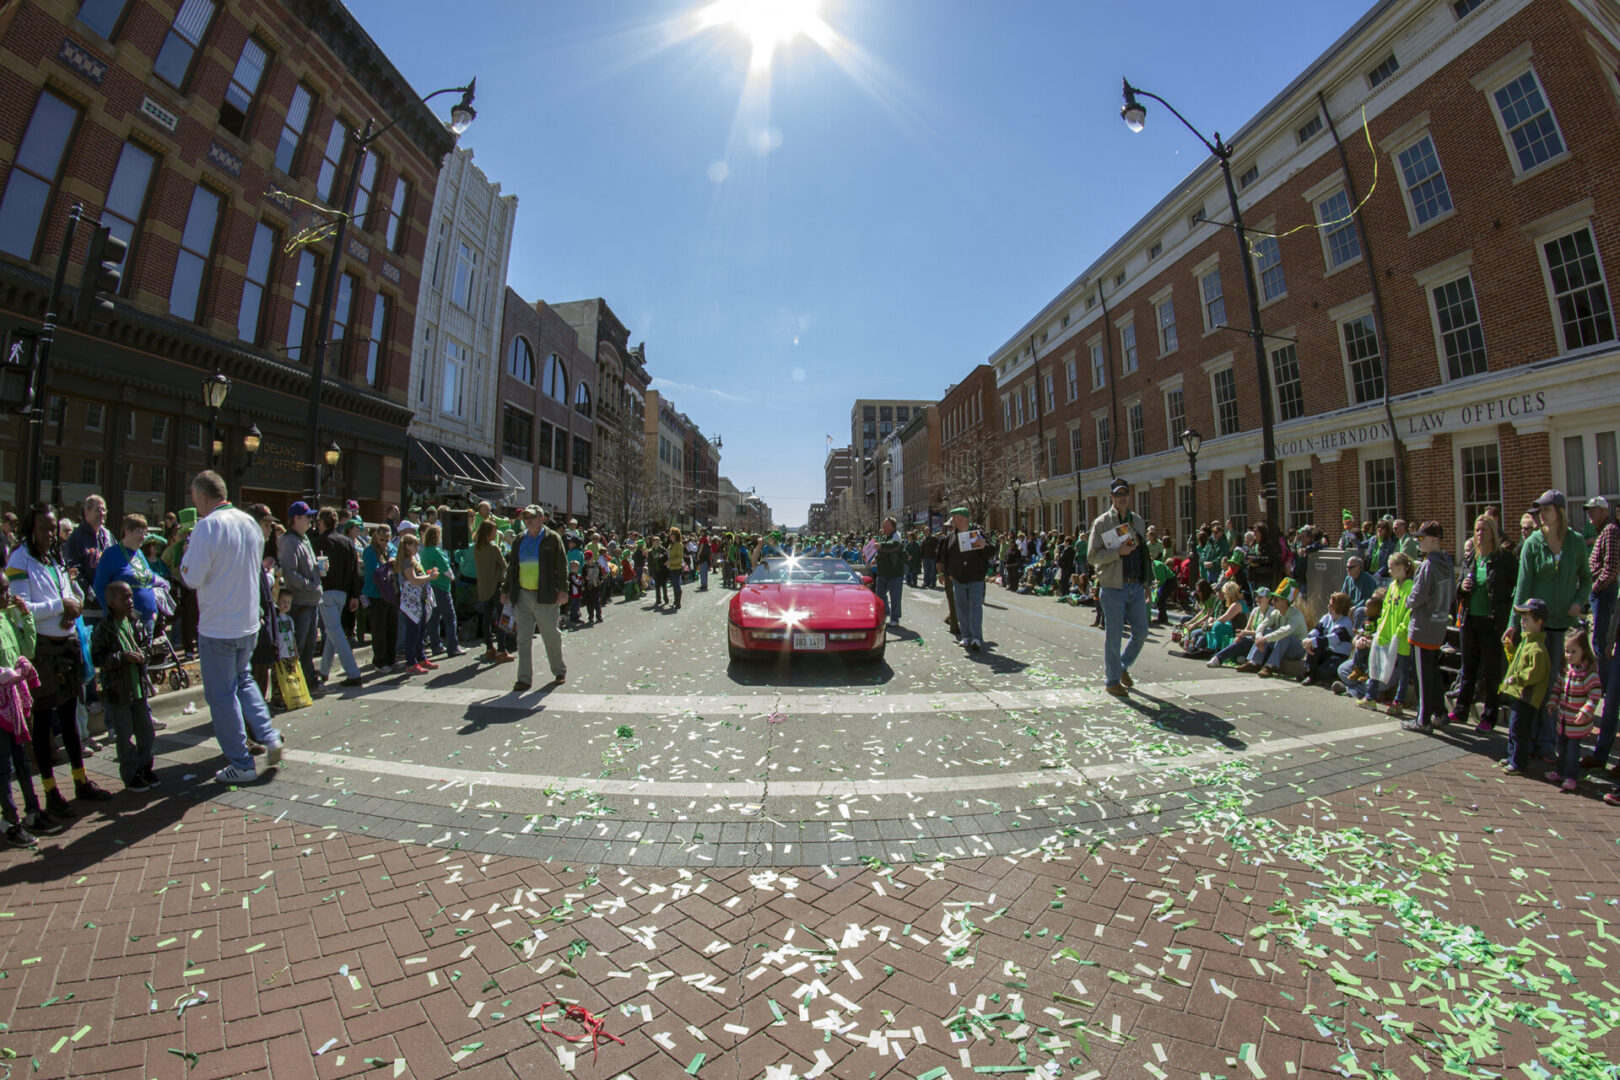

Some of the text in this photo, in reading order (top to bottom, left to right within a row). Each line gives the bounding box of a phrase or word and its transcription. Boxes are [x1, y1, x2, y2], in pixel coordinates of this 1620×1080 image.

[1274, 391, 1545, 456] NCOLN-HERNDON LAW OFFICES
